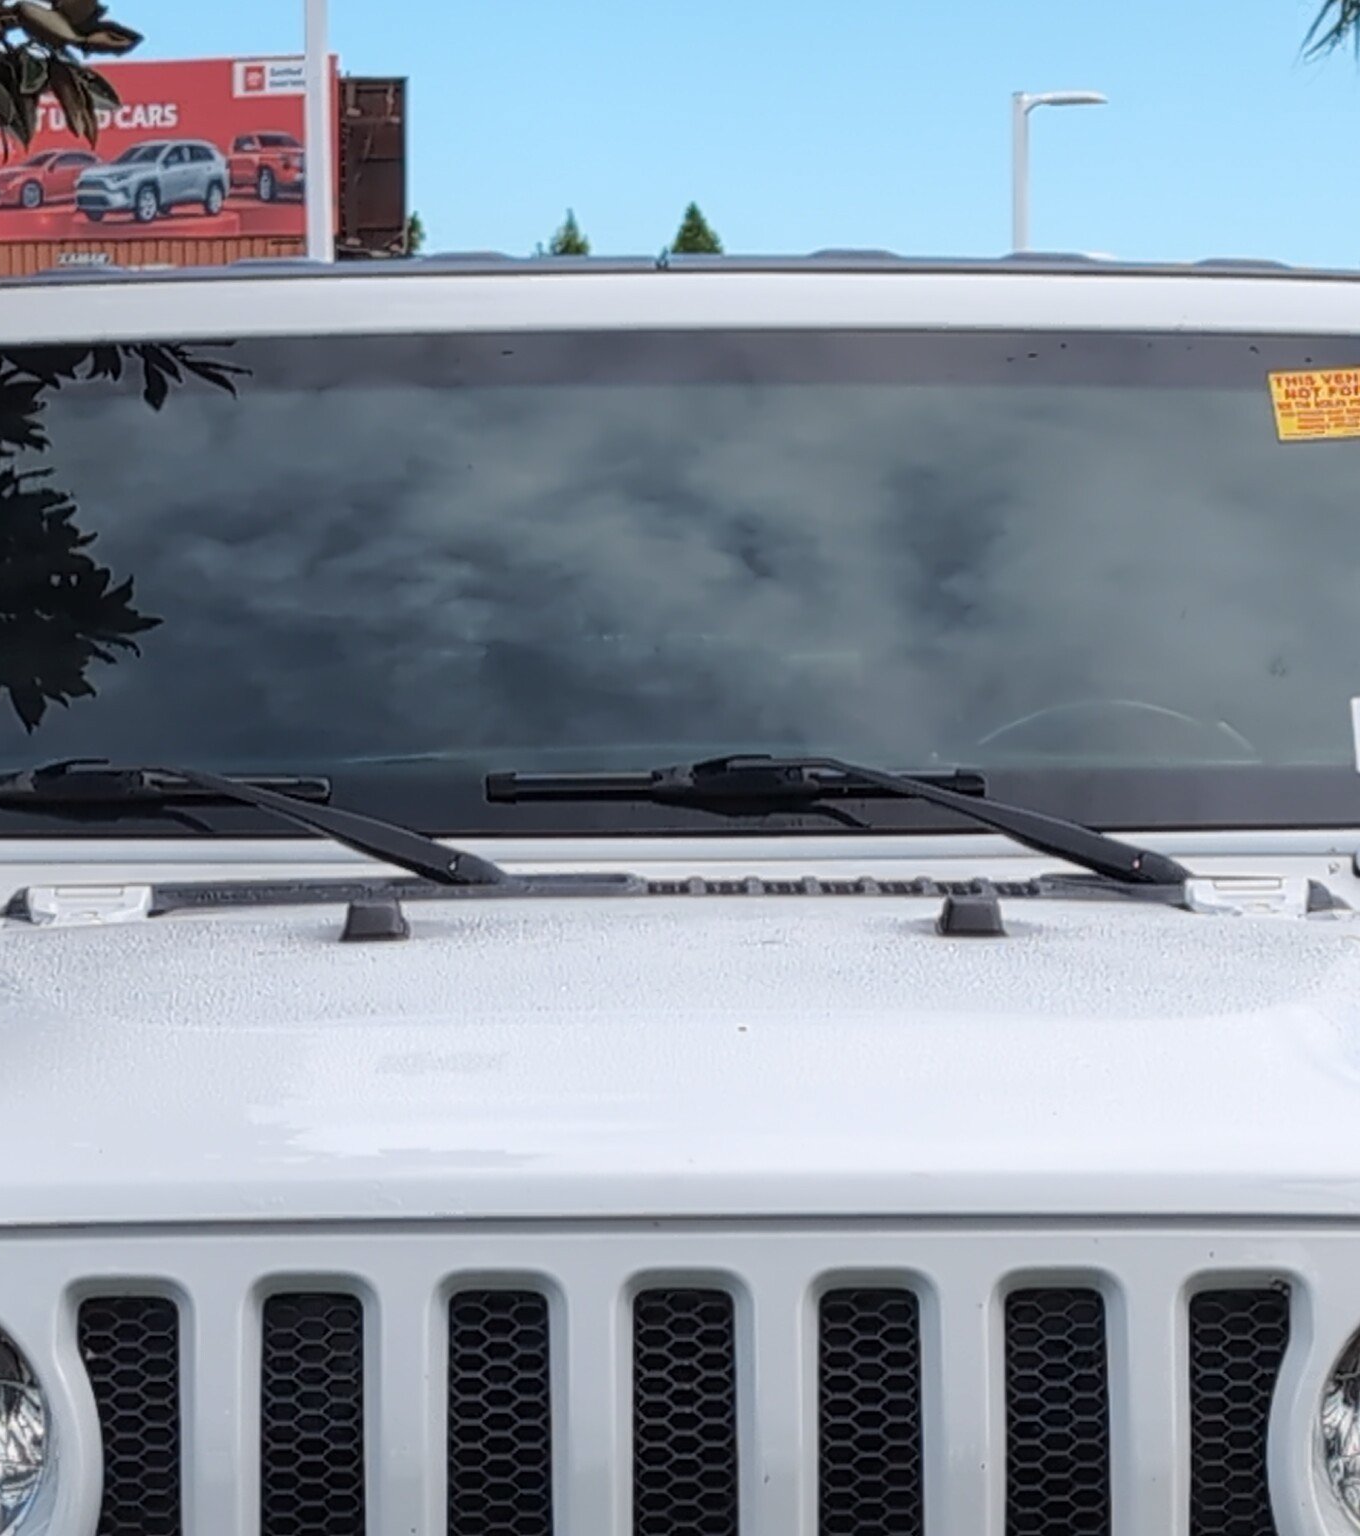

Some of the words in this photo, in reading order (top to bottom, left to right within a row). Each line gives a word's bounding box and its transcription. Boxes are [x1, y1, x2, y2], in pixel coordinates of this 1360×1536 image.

[115, 103, 178, 129] CARS
[1274, 376, 1315, 388] THIS
[1284, 387, 1322, 400] NOT
